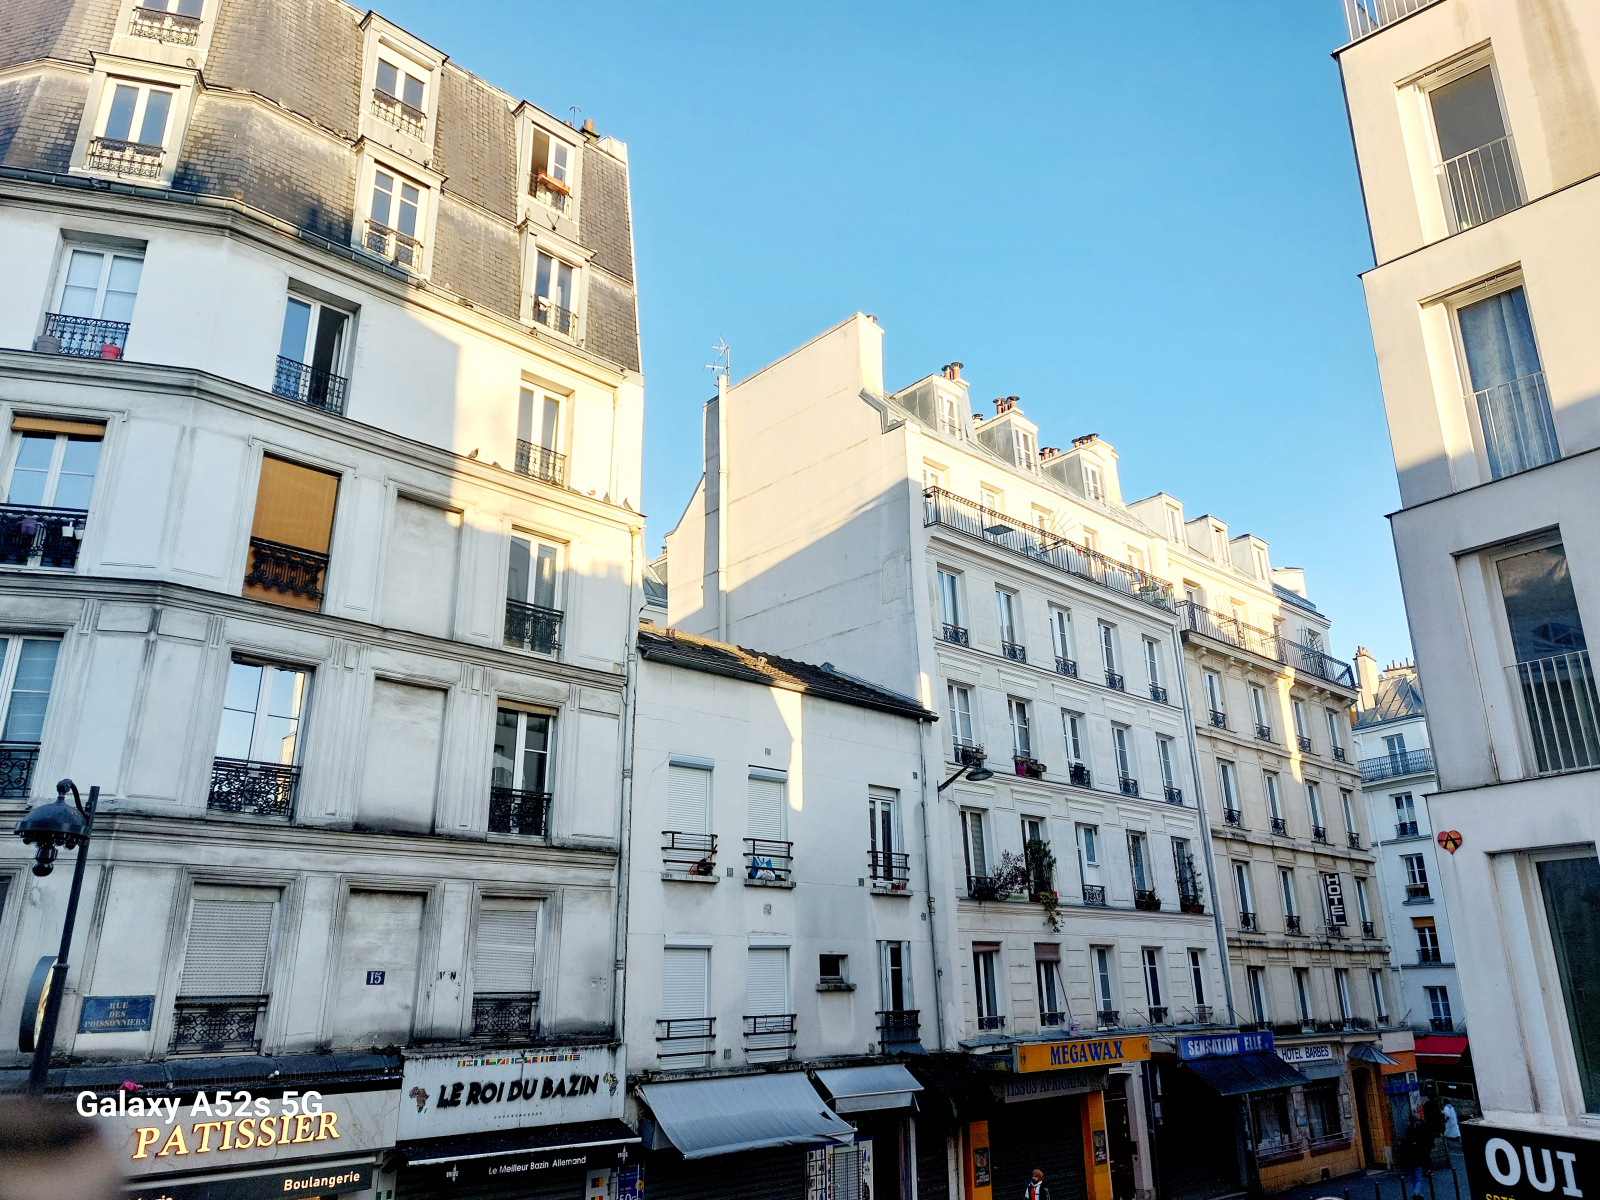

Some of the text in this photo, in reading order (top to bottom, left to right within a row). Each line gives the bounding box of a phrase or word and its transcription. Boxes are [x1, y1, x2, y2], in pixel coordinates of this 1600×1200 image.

[1325, 874, 1346, 925] HOTEL
[369, 972, 382, 984] 15
[109, 1001, 129, 1009] RUE
[84, 1019, 147, 1028] POISSONNIERS
[1050, 1040, 1124, 1066] MEGAWAX
[1188, 1037, 1239, 1056] SENSATION
[1244, 1036, 1263, 1050] ELLE
[1282, 1045, 1330, 1061] HOTEL BARBES
[436, 1074, 600, 1109] LE ROI DU BAZIN
[1006, 1080, 1037, 1096] TISSUS
[133, 1111, 340, 1159] PATISSIER
[499, 1163, 529, 1173] Meilleur
[530, 1161, 549, 1169] Bazin
[552, 1156, 586, 1167] Allemand
[1485, 1138, 1583, 1198] OUI
[284, 1171, 360, 1191] Boulangerie
